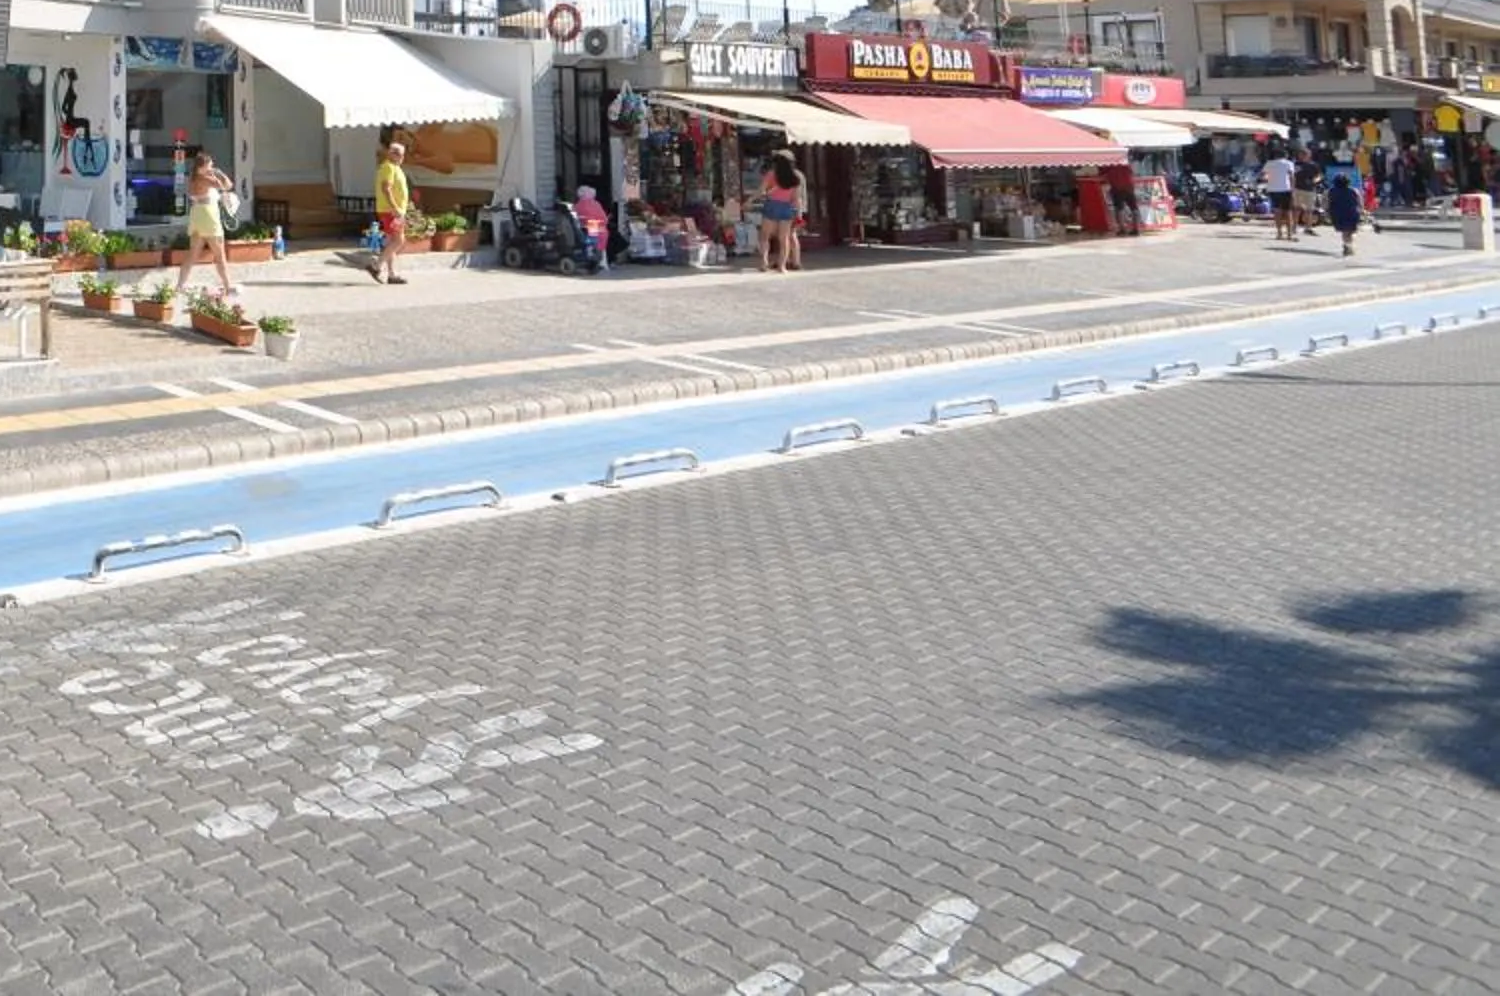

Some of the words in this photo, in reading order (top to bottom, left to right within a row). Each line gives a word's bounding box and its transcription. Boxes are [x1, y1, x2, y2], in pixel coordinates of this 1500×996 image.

[690, 43, 723, 74] GIFT
[852, 39, 907, 67] PASHA
[931, 43, 973, 70] BABA
